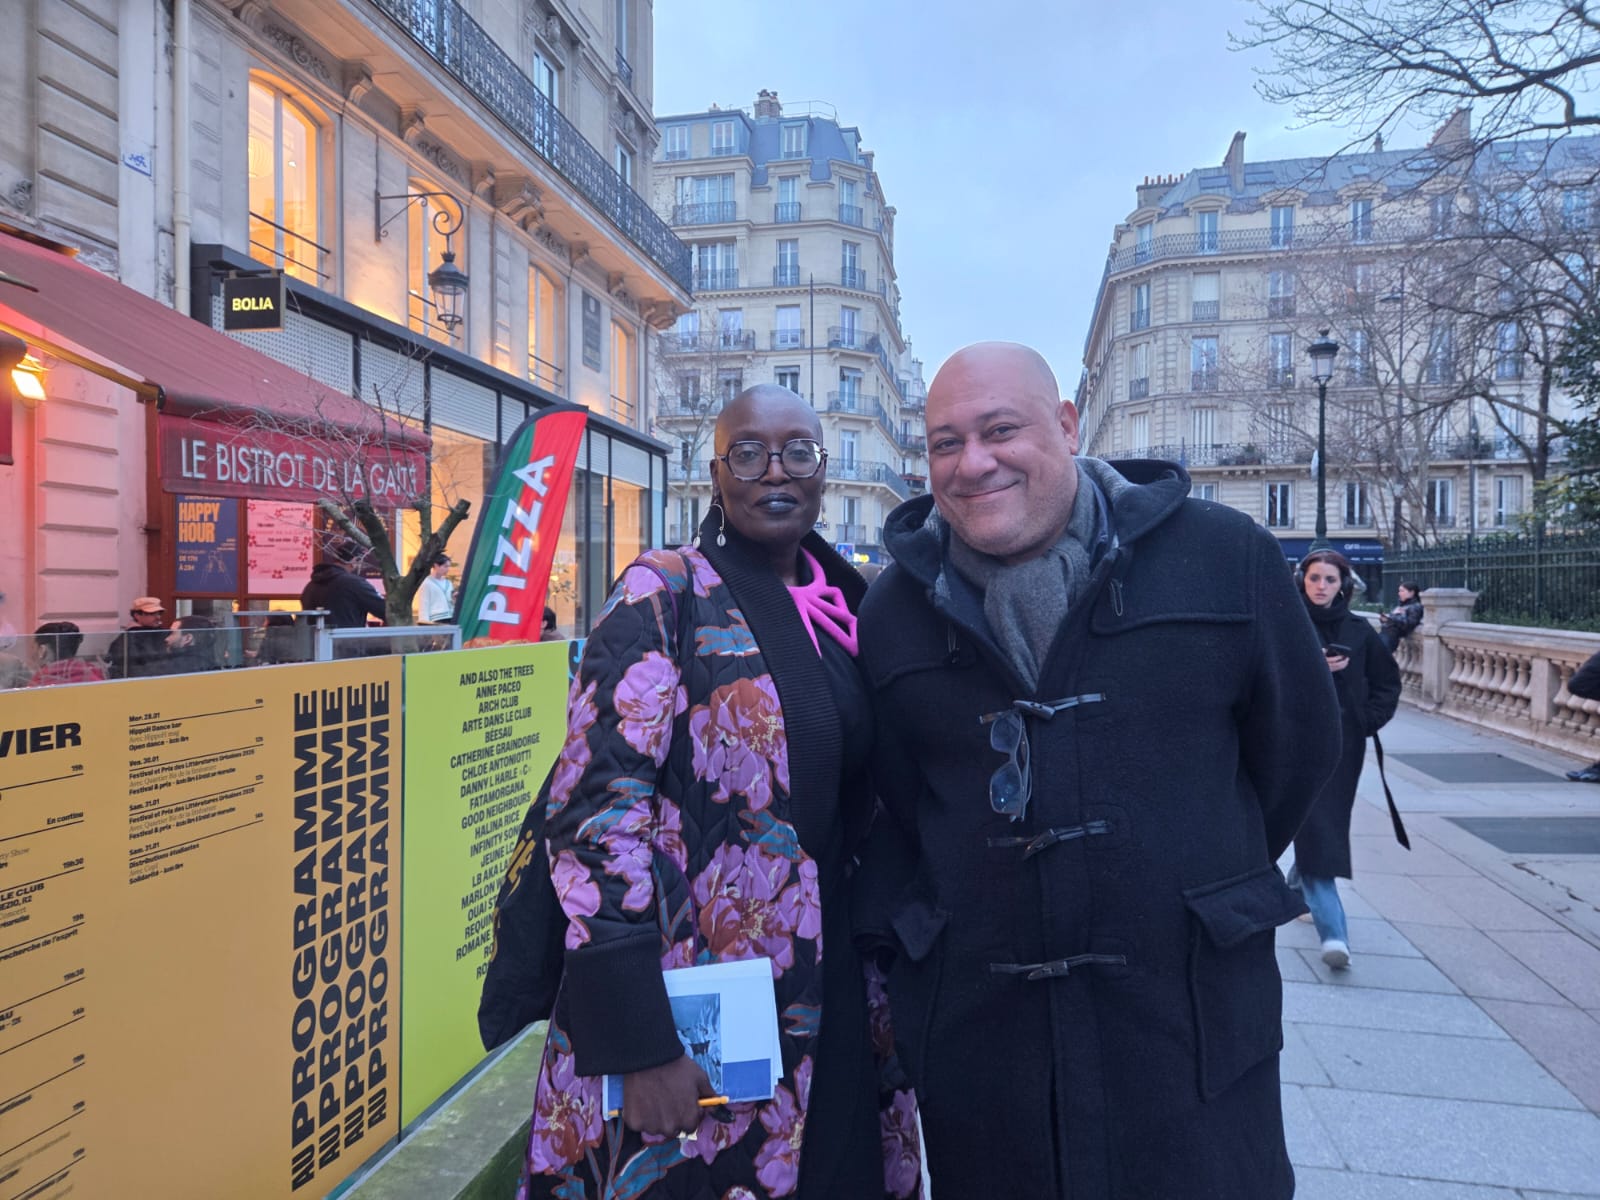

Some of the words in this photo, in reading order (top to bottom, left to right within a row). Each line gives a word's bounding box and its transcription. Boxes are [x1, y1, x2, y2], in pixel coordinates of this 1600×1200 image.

[232, 297, 274, 311] BOLIA
[181, 438, 206, 479] LE
[216, 443, 306, 488] BISTROT
[312, 456, 337, 491] DE
[344, 461, 366, 493] LA
[179, 502, 220, 522] HAPPY
[179, 522, 216, 543] HOUR
[478, 454, 556, 625] PIZZA
[460, 672, 477, 686] AND
[479, 669, 498, 683] ALSO
[499, 667, 512, 679] THE
[514, 664, 534, 677] TREES
[476, 684, 497, 699] ANNE
[498, 680, 521, 694] PACEO
[479, 699, 499, 714] ARCH
[500, 695, 519, 709] CLUB
[152, 723, 171, 732] Dance
[462, 718, 482, 734] ARTE
[484, 713, 504, 729] DANS
[505, 711, 513, 723] LE
[514, 706, 532, 721] CLUB
[129, 743, 145, 751] Open
[146, 740, 165, 748] dance
[485, 725, 513, 743] BÉESAU
[450, 745, 495, 769] CATHERINE
[496, 732, 540, 755] GRAINDORGE
[489, 749, 531, 773] ANTONIOTTI
[129, 769, 153, 780] Festival
[460, 777, 488, 798] DANNY
[489, 776, 494, 788] L
[495, 767, 518, 786] HARLE
[129, 785, 153, 796] Festival
[470, 780, 525, 811] FATAMORGANA
[47, 817, 56, 825] En
[129, 813, 153, 825] Festival
[461, 810, 485, 830] GOOD
[486, 791, 531, 819] NEIGHBOURS
[129, 829, 153, 840] Festival
[475, 817, 503, 840] HALINA
[504, 810, 520, 827] RICE
[470, 832, 503, 858] INFINITY
[481, 846, 505, 868] JEUNE
[368, 680, 389, 1091] PROGRAMME
[472, 873, 482, 888] LB
[483, 864, 499, 882] AKA
[16, 883, 45, 897] CLUB
[344, 683, 367, 1109] PROGRAMME
[461, 883, 495, 910] MARLON
[292, 690, 317, 1149] PROGRAMME
[319, 687, 343, 1129] PROGRAMME
[456, 929, 491, 962] ROMANE
[368, 1087, 387, 1130] AU
[344, 1104, 365, 1149] AU
[319, 1123, 341, 1170] AU
[292, 1144, 314, 1192] AU
